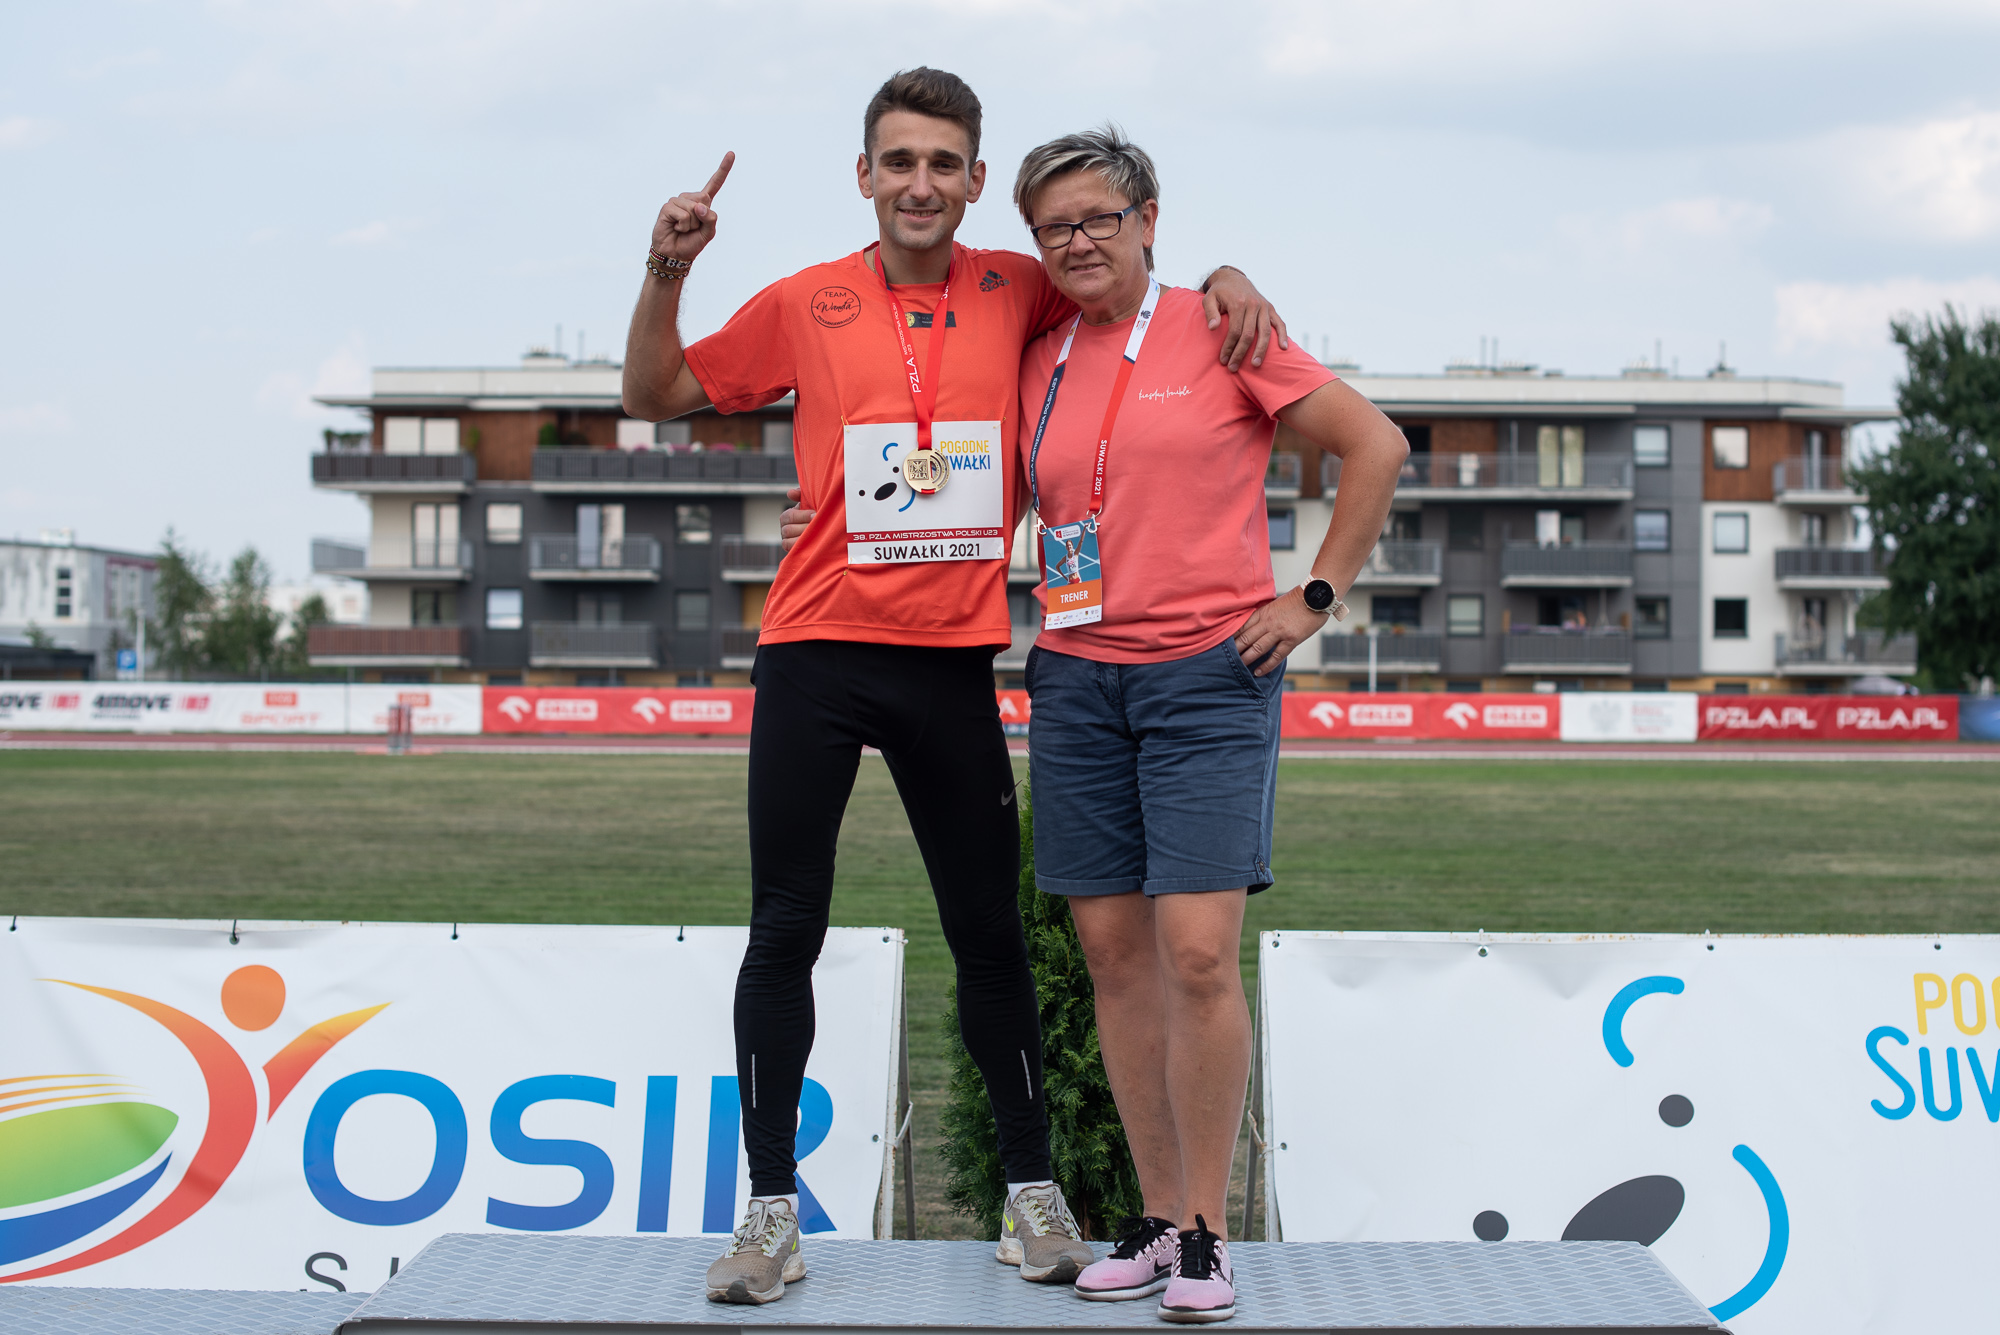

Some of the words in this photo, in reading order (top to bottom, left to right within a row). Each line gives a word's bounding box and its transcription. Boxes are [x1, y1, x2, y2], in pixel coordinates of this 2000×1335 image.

[906, 356, 922, 393] PZLA
[940, 439, 990, 454] POGODNE
[1096, 439, 1108, 475] SUWAŁKI
[945, 454, 991, 471] WAŁKI
[1094, 476, 1103, 496] 2021
[892, 531, 955, 540] MISTRZOSTWA
[874, 544, 944, 561] SUWAŁKI
[949, 543, 981, 558] 2021
[1060, 590, 1089, 604] TRENER
[1706, 706, 1818, 730] PZLA.PL
[1836, 706, 1949, 730] PZLA.PL
[1913, 972, 2000, 1036] PO
[303, 1069, 837, 1234] OSIR
